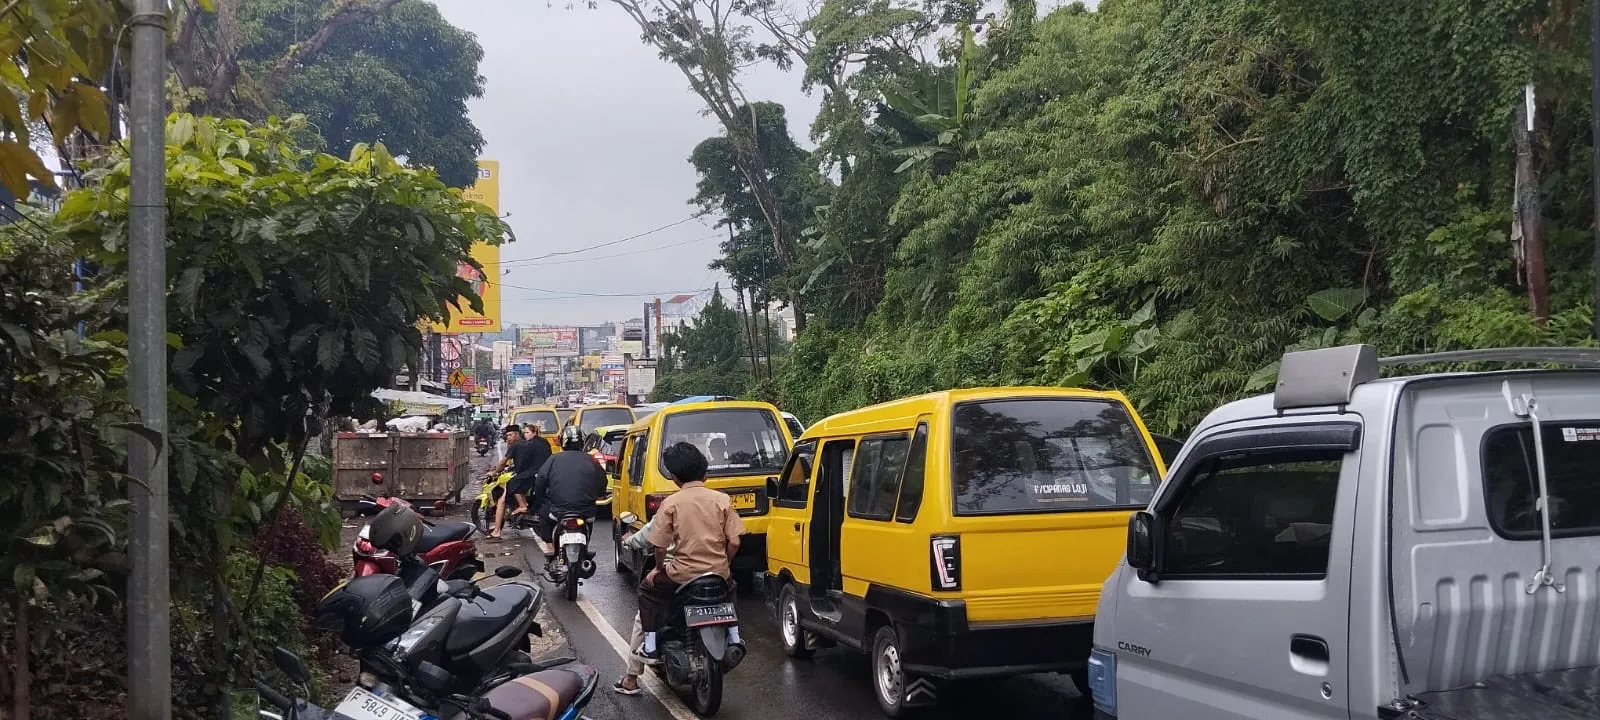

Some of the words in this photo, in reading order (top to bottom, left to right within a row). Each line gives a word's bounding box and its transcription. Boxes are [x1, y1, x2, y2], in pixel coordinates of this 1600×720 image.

[1118, 641, 1152, 657] CARRY
[350, 692, 362, 702] F
[361, 698, 389, 718] 5849
